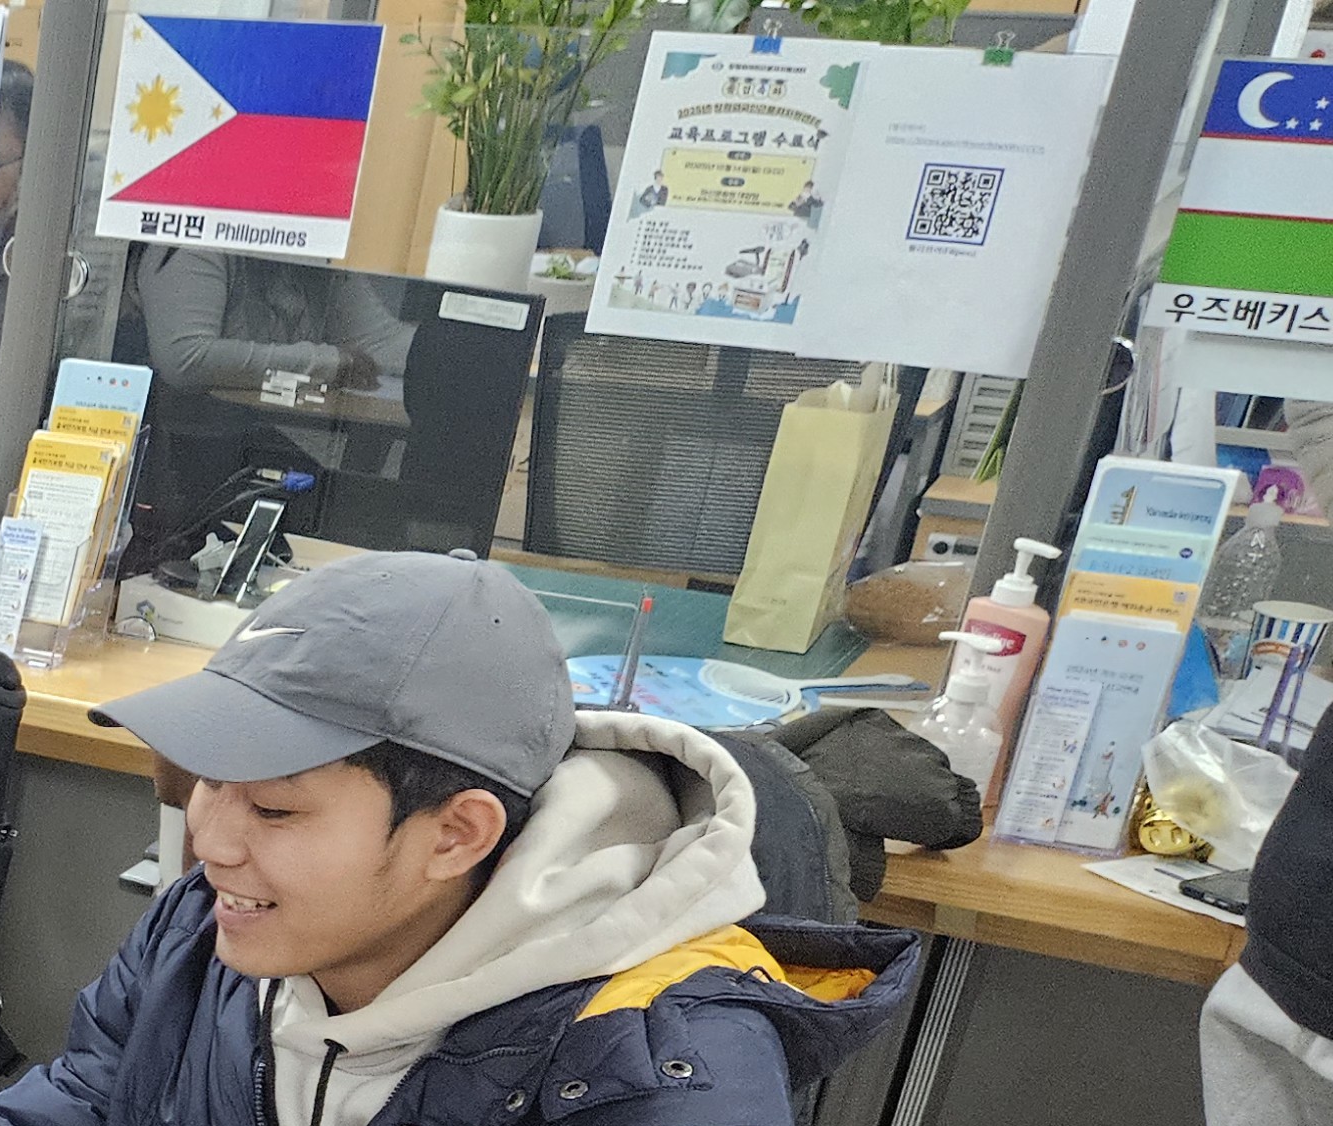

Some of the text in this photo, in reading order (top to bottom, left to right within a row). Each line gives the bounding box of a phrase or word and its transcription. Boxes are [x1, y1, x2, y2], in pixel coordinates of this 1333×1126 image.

[668, 126, 821, 151] 교육프로그램 수료식
[140, 210, 308, 248] 필리핀 Philippines
